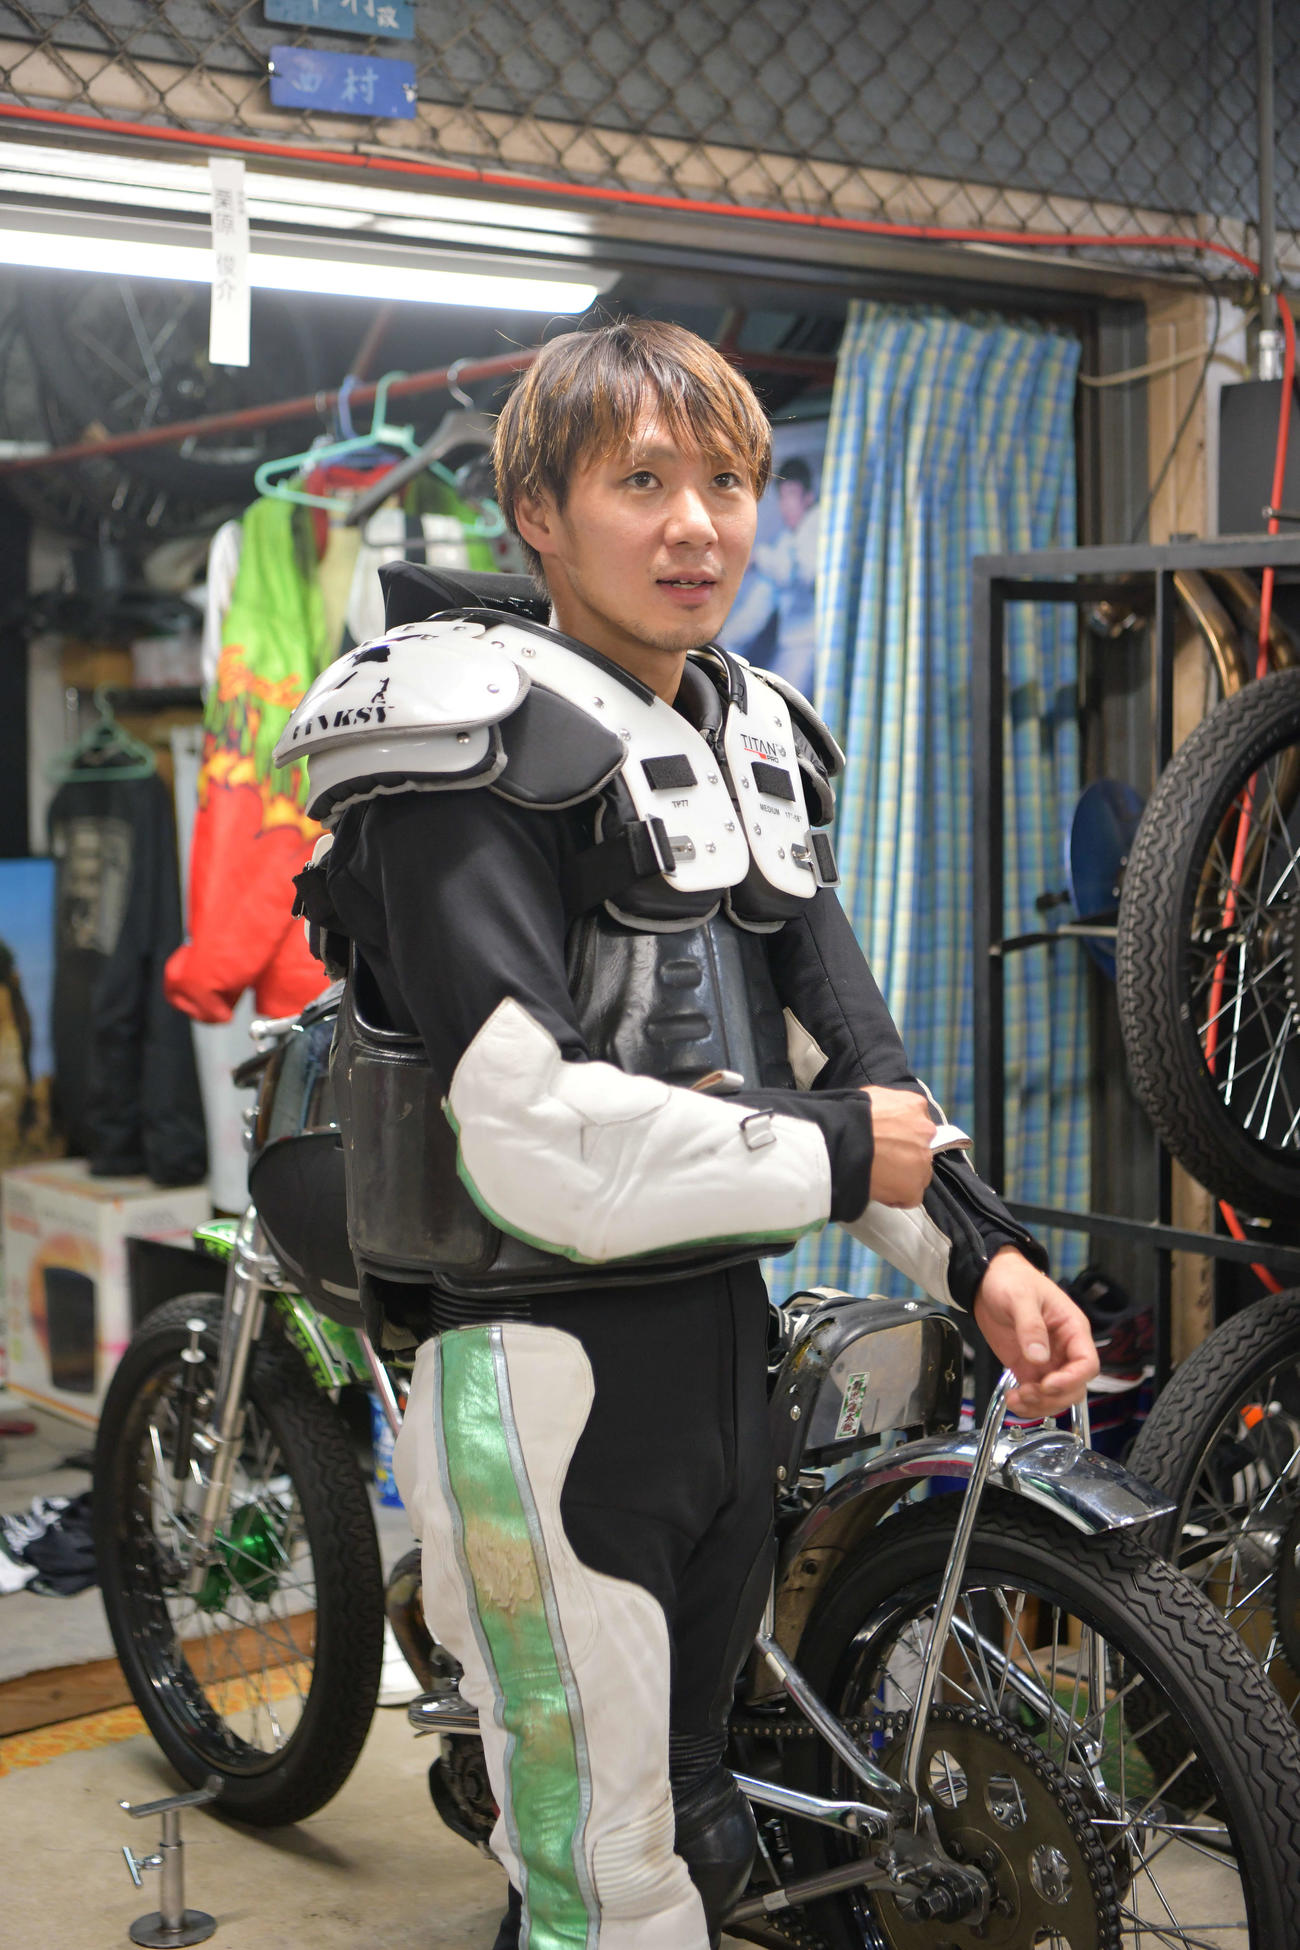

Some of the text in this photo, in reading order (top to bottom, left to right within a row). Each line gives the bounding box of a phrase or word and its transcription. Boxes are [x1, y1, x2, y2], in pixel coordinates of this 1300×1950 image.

[740, 733, 777, 756] TITAN
[766, 755, 779, 764] PRO
[759, 803, 781, 816] MEDIUM
